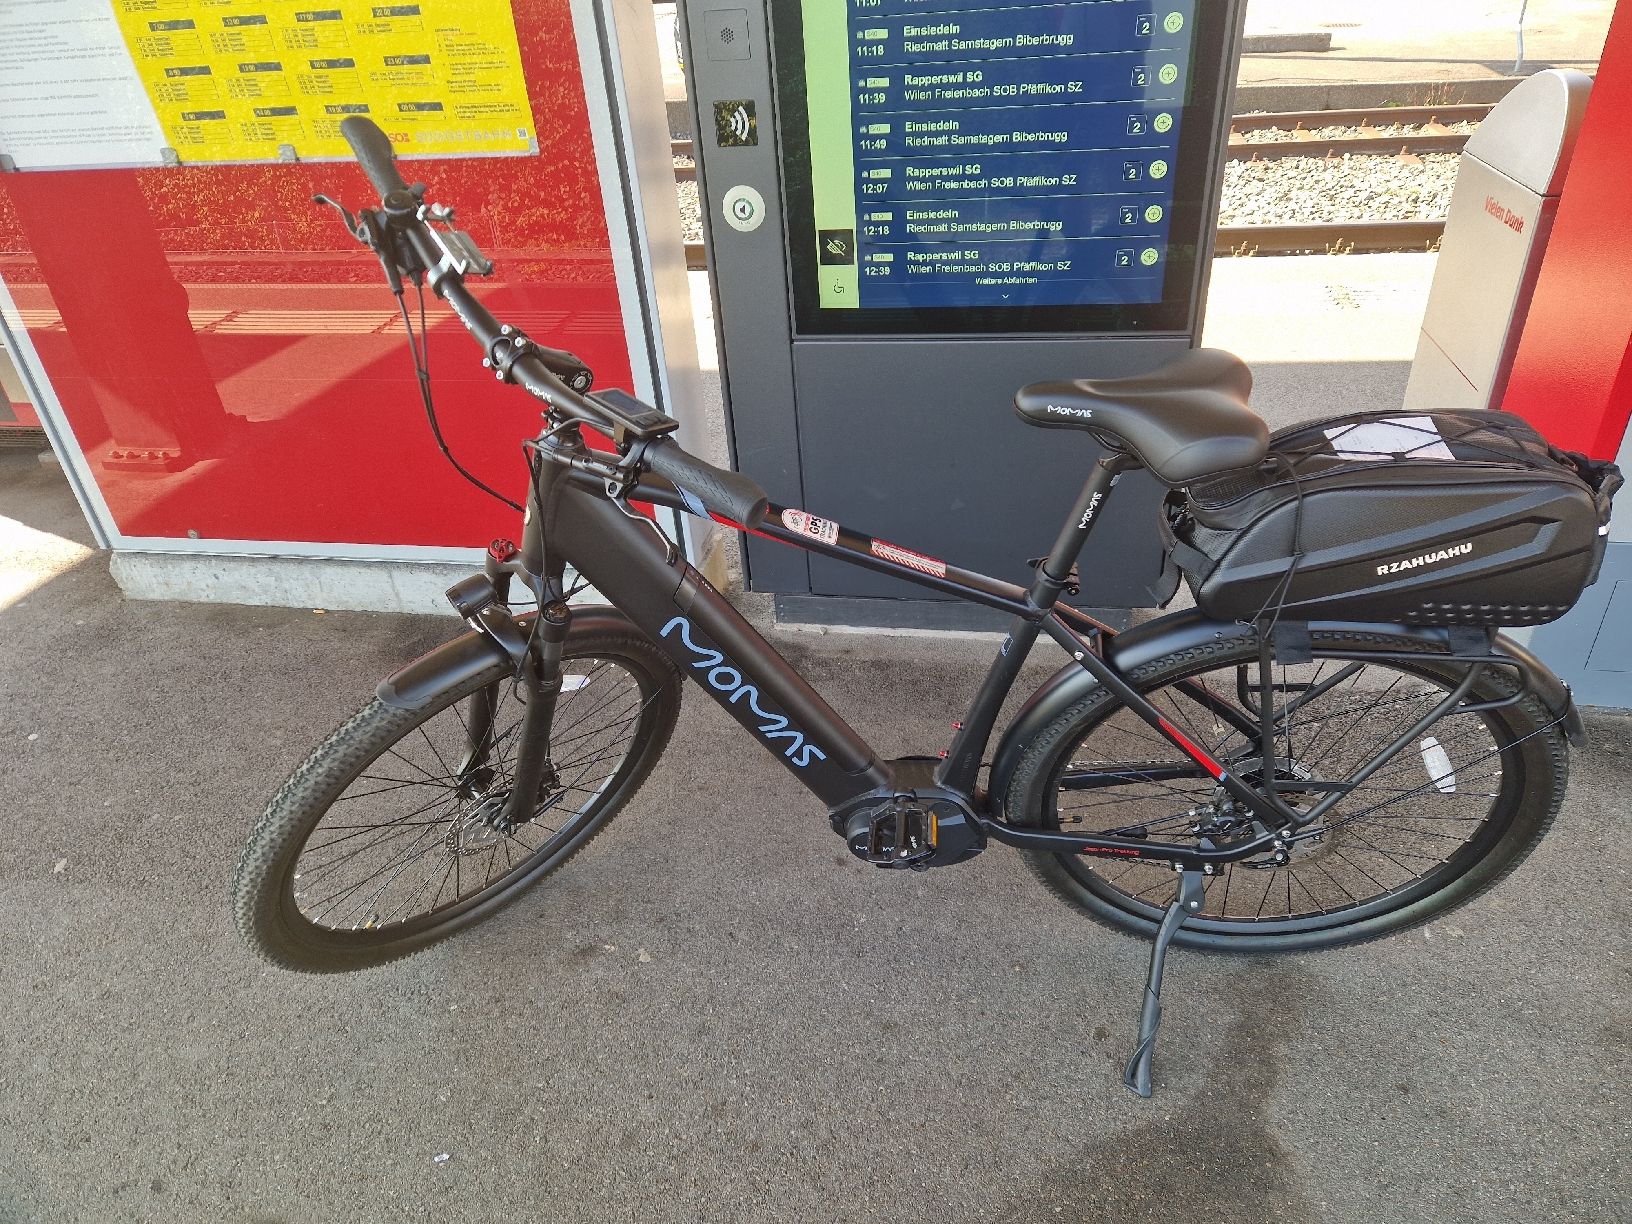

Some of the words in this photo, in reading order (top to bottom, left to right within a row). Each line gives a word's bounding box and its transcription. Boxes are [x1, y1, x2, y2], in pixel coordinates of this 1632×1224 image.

[903, 23, 960, 37] Einsiedeln
[1141, 22, 1150, 34] 2
[904, 40, 949, 53] Riedmatt
[1016, 34, 1074, 46] Biberbrugg
[856, 45, 884, 56] 11:18
[904, 72, 963, 86] Rapperswil
[966, 71, 983, 82] SG
[1137, 74, 1145, 85] 2
[904, 89, 932, 101] Wilen
[935, 86, 990, 99] Freienbach
[993, 85, 1017, 96] SOB
[1020, 83, 1064, 95] Pfäffikon
[1067, 81, 1082, 92] SZ
[858, 93, 886, 104] 11:39
[905, 120, 959, 132] Einsiedeln
[1132, 121, 1141, 133] 2
[860, 139, 887, 150] 11:49
[905, 135, 949, 146] Riedmatt
[1012, 131, 1068, 143] Biberbrugg
[906, 164, 963, 178] Rapperswil
[964, 164, 981, 174] SG
[1128, 168, 1136, 179] 2
[906, 180, 932, 191] Wilen
[935, 178, 988, 189] Freienbach
[990, 177, 1013, 187] SOB
[1016, 176, 1059, 187] Pfäffikon
[1061, 174, 1077, 185] SZ
[862, 184, 888, 194] 12:07
[906, 209, 958, 220] Einsiedeln
[1124, 213, 1133, 223] 2
[1484, 194, 1505, 222] Vielen
[1503, 208, 1524, 234] Dank
[863, 226, 890, 235] 12:18
[906, 223, 948, 233] Riedmatt
[1010, 220, 1063, 231] Biberbrugg
[907, 250, 962, 262] Rapperswil
[964, 250, 979, 259] SG
[1121, 256, 1129, 265] 2
[864, 266, 890, 276] 12:39
[907, 264, 933, 274] Wilen
[935, 263, 986, 273] Freienbach
[988, 262, 1011, 272] SOB
[1013, 262, 1054, 272] Pfäffikon
[1057, 261, 1072, 270] SZ
[1003, 276, 1038, 284] Abfahrten
[1047, 404, 1093, 418] MOMAS
[1078, 491, 1102, 529] MOMAS
[809, 516, 822, 535] GPS
[1376, 542, 1473, 576] RZAHUAHU
[659, 616, 827, 767] MOMAS
